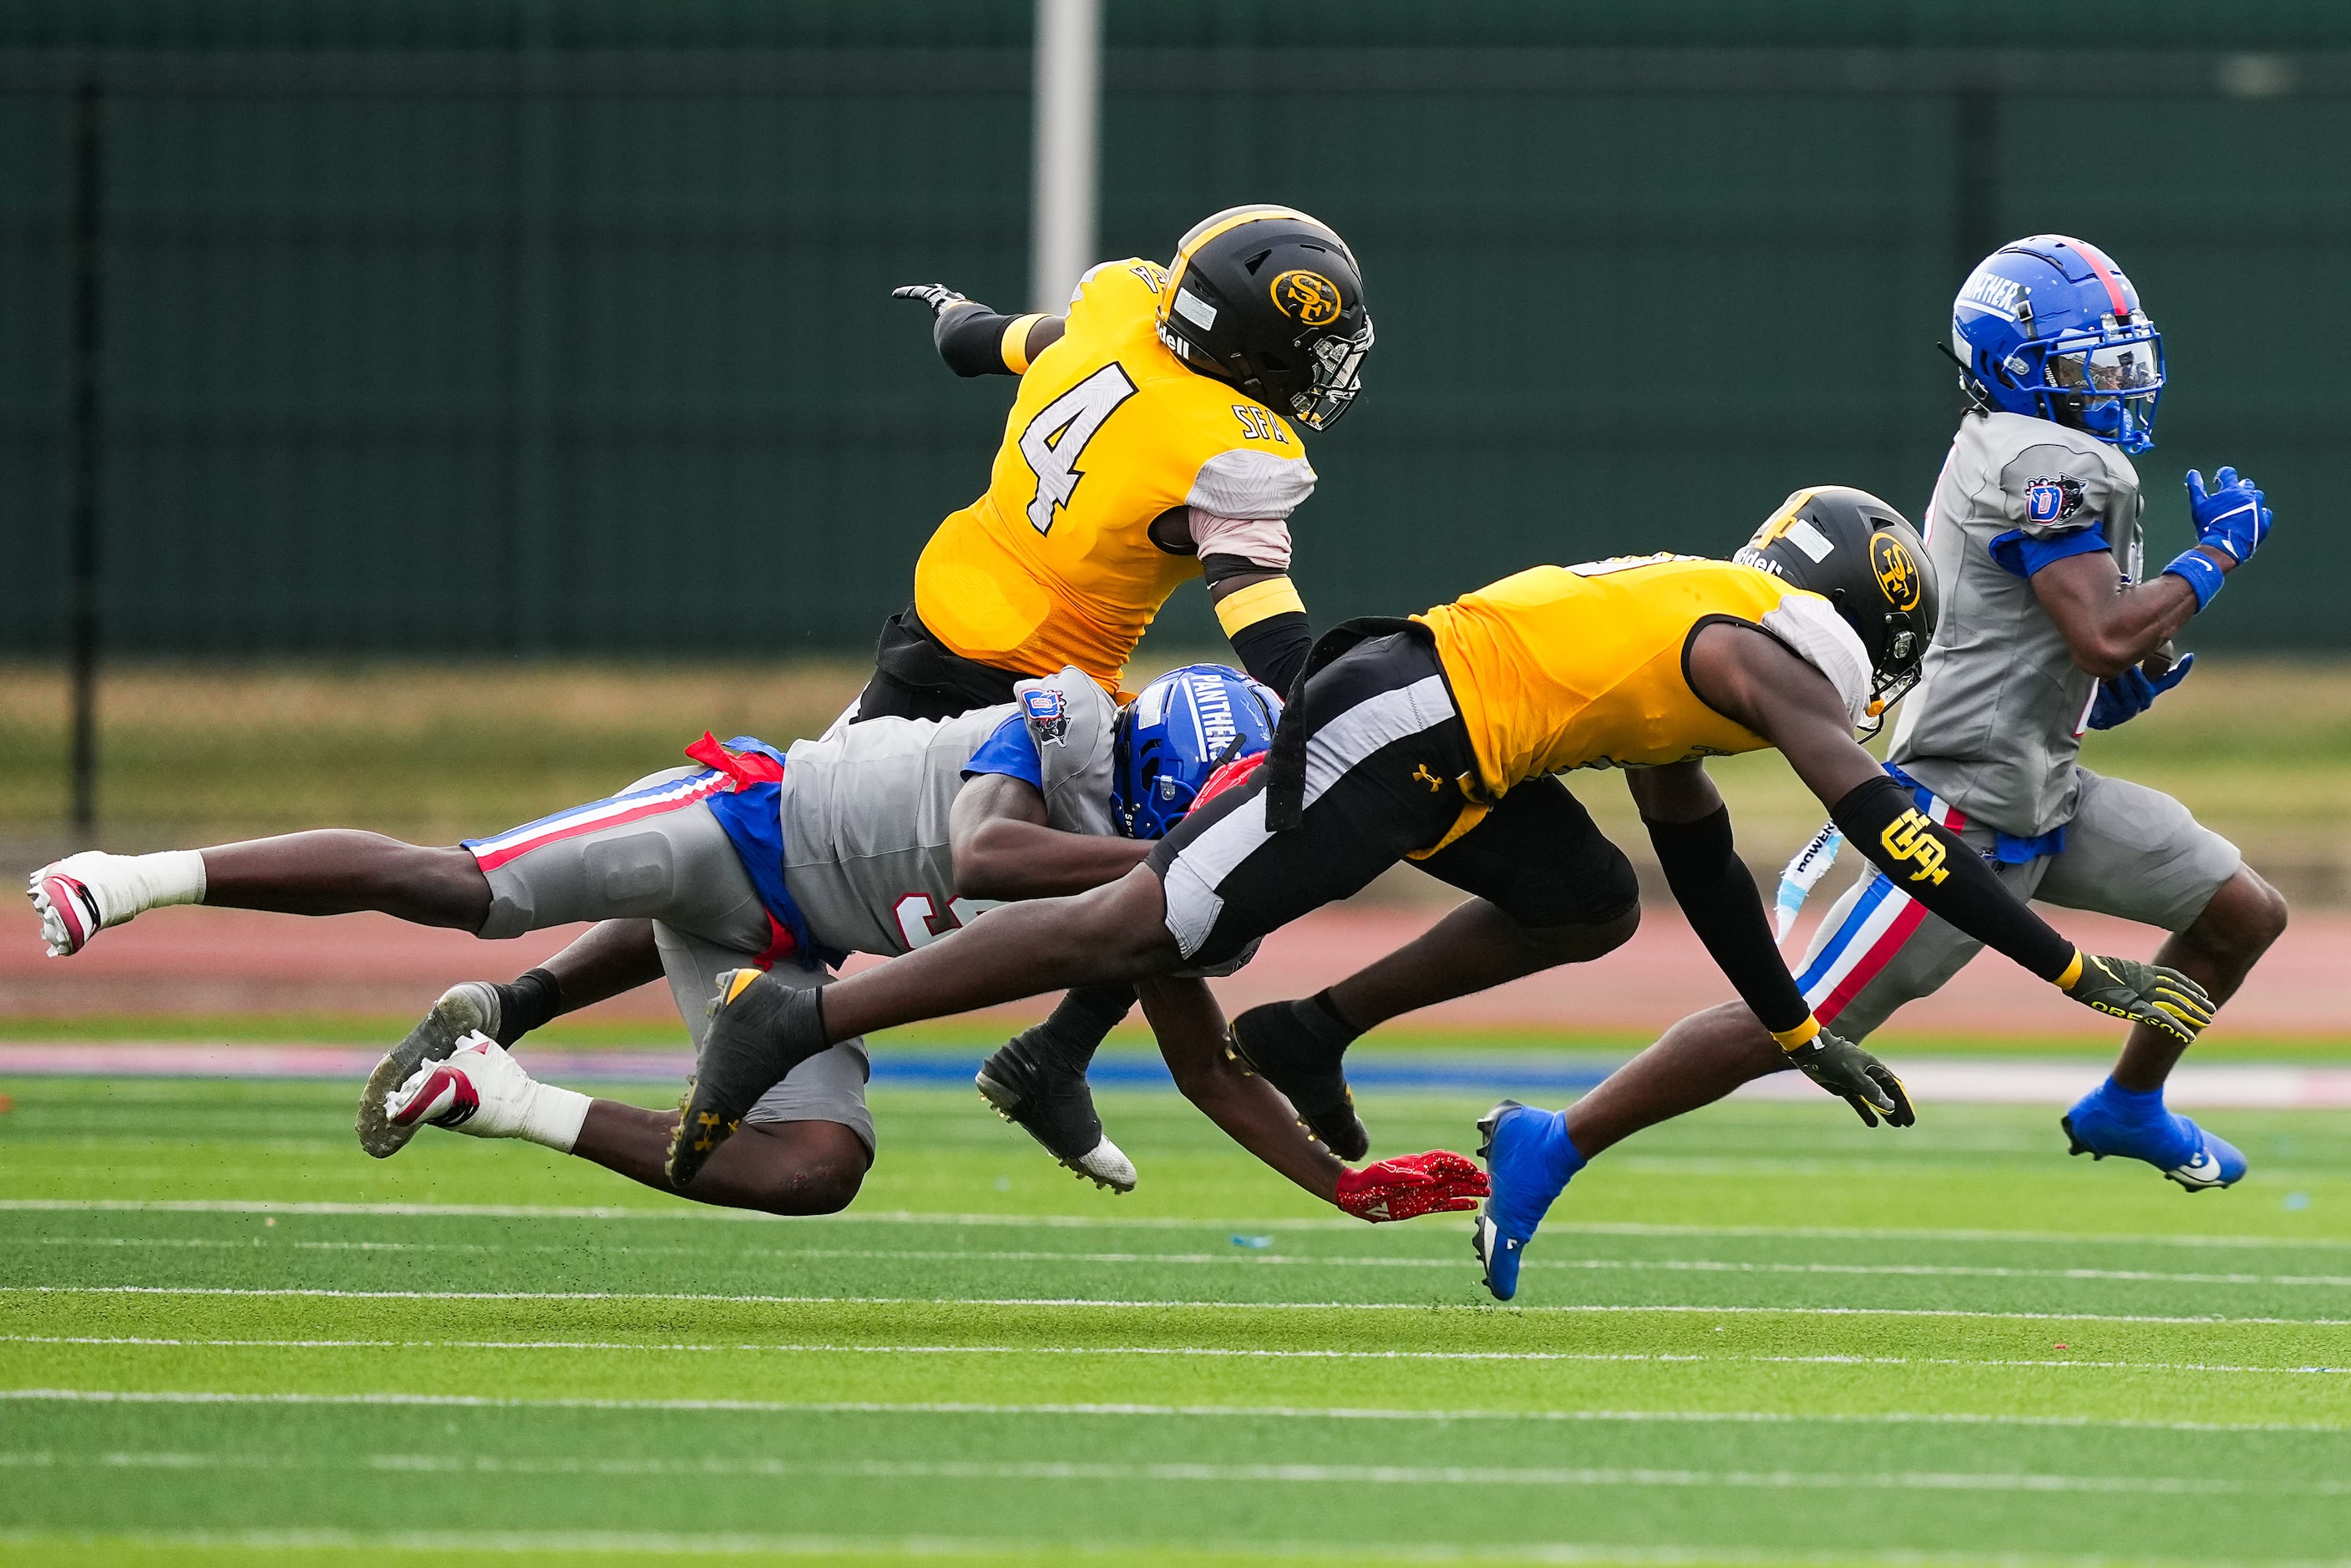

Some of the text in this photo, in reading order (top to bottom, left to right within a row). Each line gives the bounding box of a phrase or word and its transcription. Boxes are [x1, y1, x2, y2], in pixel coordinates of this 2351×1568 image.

[1287, 274, 1332, 321] SF
[1231, 404, 1290, 444] SFA
[1018, 361, 1140, 538] 4
[1796, 822, 1835, 873] POWER
